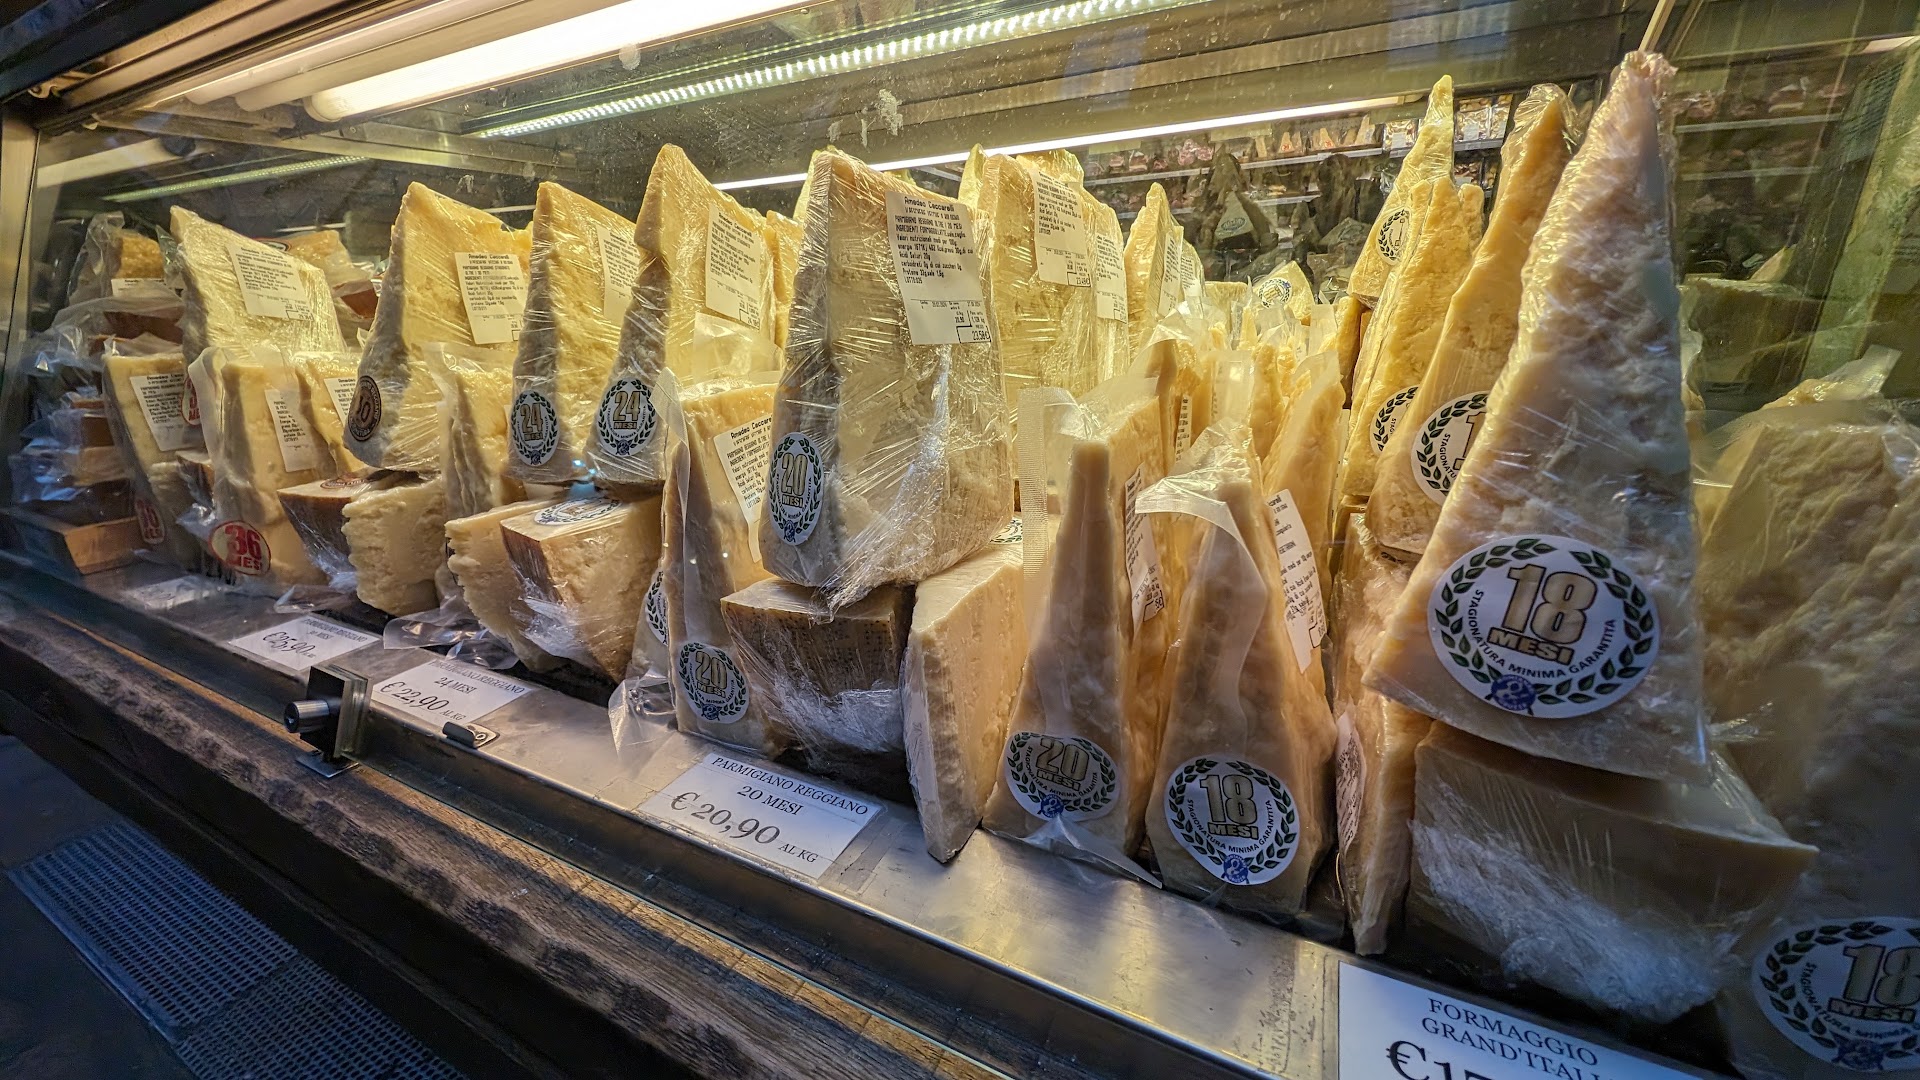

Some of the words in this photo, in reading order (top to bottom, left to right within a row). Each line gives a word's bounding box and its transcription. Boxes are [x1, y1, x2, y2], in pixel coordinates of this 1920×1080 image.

[520, 403, 543, 433] 24
[613, 390, 641, 422] 24
[613, 422, 637, 430] MESI
[730, 426, 750, 439] Amedeo
[1440, 434, 1457, 479] STAGIONATU
[781, 452, 808, 496] 20
[782, 494, 804, 508] MESI
[225, 525, 262, 560] 36
[1507, 564, 1598, 645] 18
[1467, 589, 1506, 667] STAGIONATURA
[1487, 626, 1576, 666] MESI
[1569, 618, 1617, 674] GARANTITA
[434, 677, 452, 687] 24
[448, 681, 478, 695] MESI
[476, 674, 526, 694] REGGIANO
[695, 650, 727, 690] 20
[1507, 663, 1566, 679] MINIMA
[391, 688, 450, 711] 22,90
[696, 682, 726, 699] MESI
[450, 713, 466, 721] KG
[1036, 737, 1090, 782] 20
[711, 757, 794, 790] PARMIGIANO
[792, 784, 868, 815] REGGIANO
[1036, 768, 1081, 792] MESI
[736, 786, 763, 801] 20
[762, 795, 804, 816] MESI
[1199, 774, 1257, 824] 18
[691, 803, 781, 844] 20,90
[1187, 799, 1226, 850] STAGIONATURA
[1208, 822, 1259, 840] MESI
[1259, 800, 1273, 845] GARANTITA
[778, 843, 796, 854] AL
[798, 850, 820, 864] KG
[1228, 843, 1260, 853] MINIMA
[1842, 943, 1920, 1006] 18
[1828, 997, 1917, 1023] MESI
[1421, 1016, 1612, 1080] GRAND'ITAL
[1428, 998, 1598, 1066] FORMAGGIO
